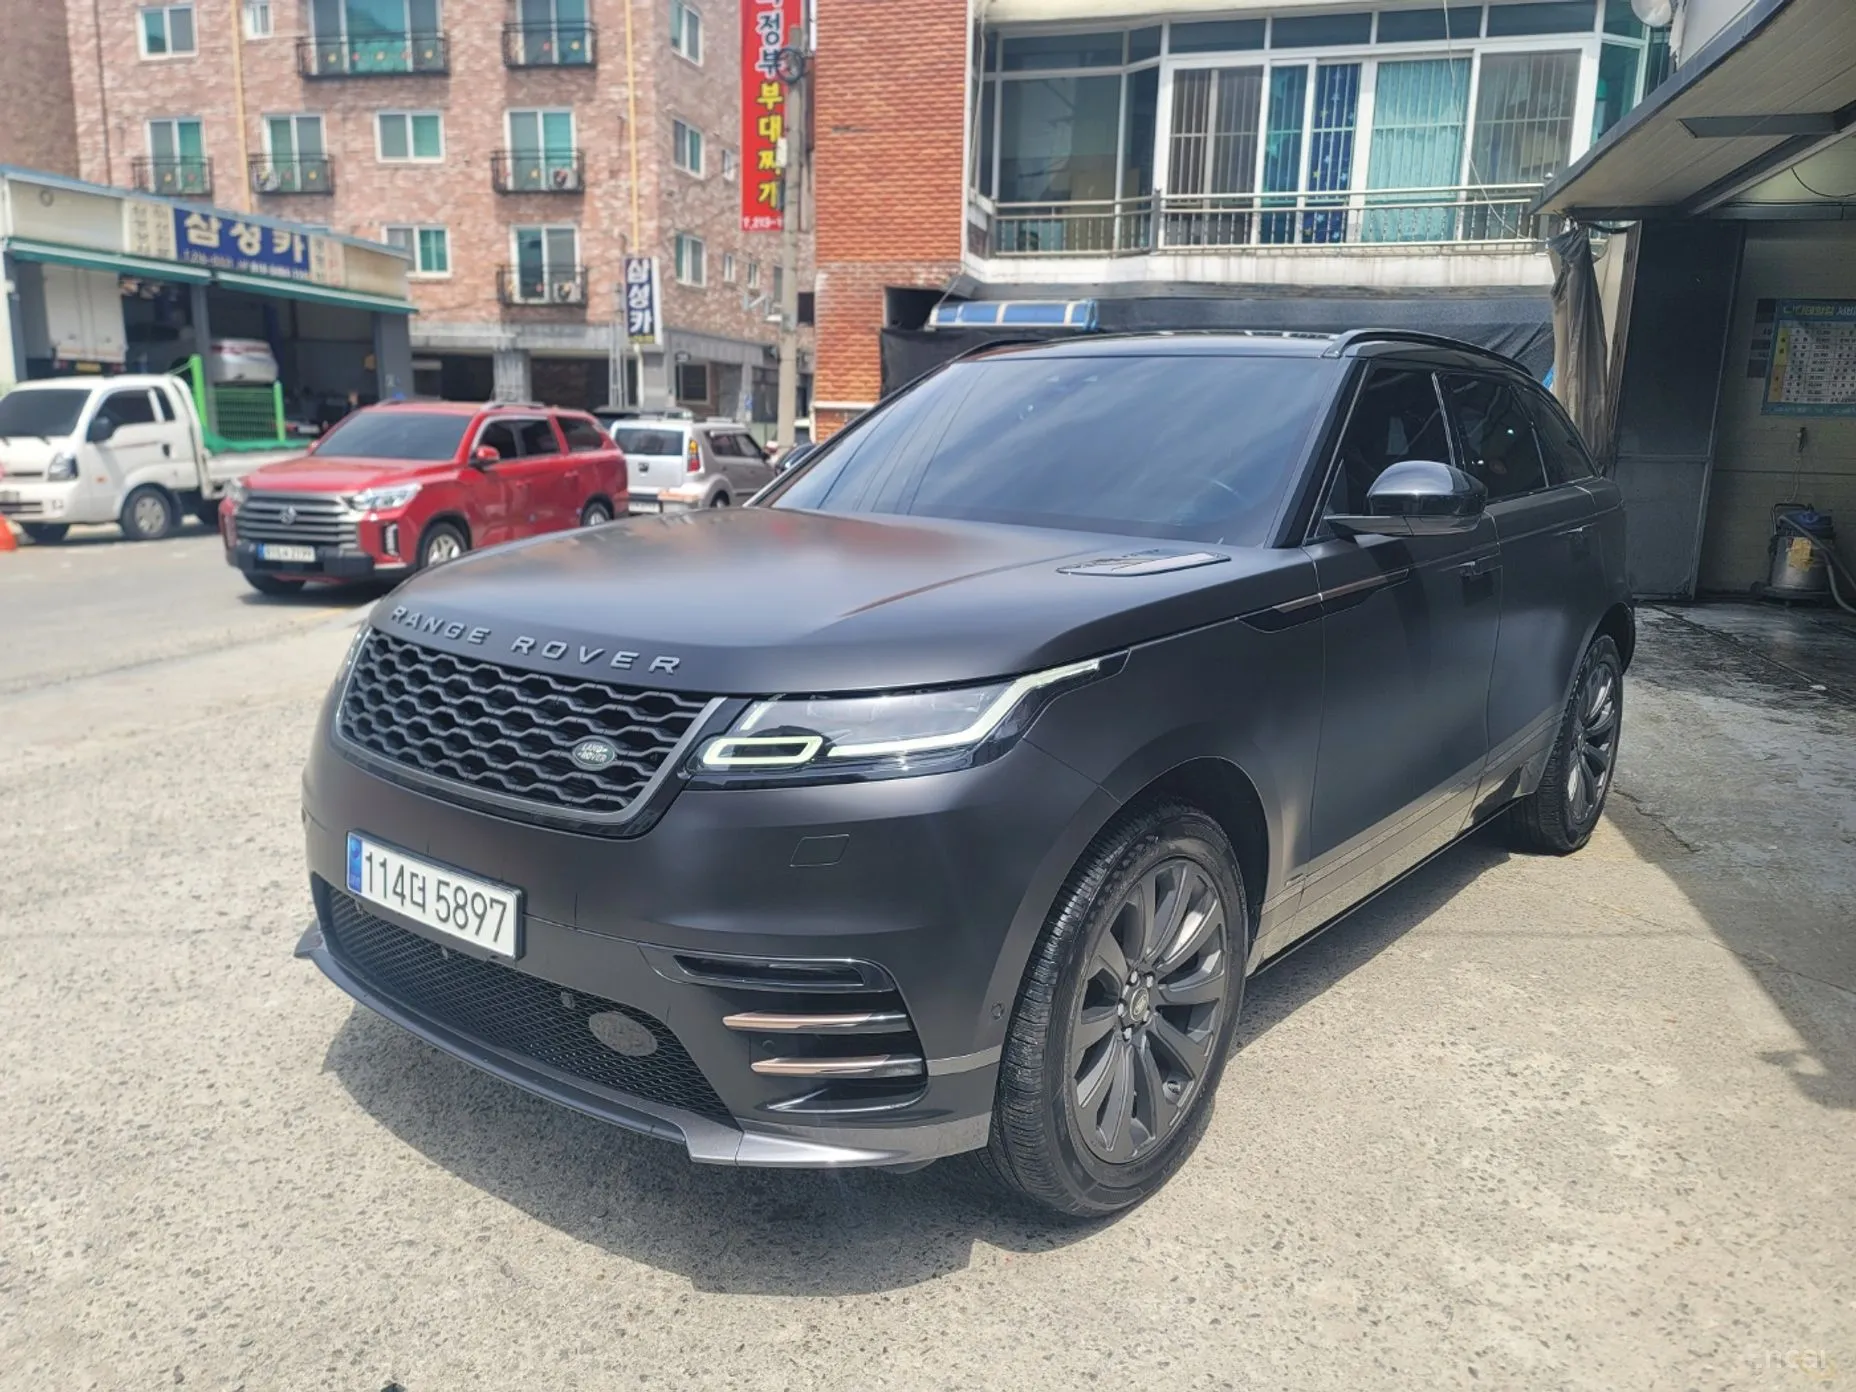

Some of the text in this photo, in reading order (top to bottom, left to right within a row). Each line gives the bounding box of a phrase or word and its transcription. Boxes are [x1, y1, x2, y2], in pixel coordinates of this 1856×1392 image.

[183, 213, 306, 264] 삼성카
[627, 258, 653, 333] 삼성카
[390, 605, 681, 674] RANGE ROVER
[364, 851, 508, 944] 114더 5897
